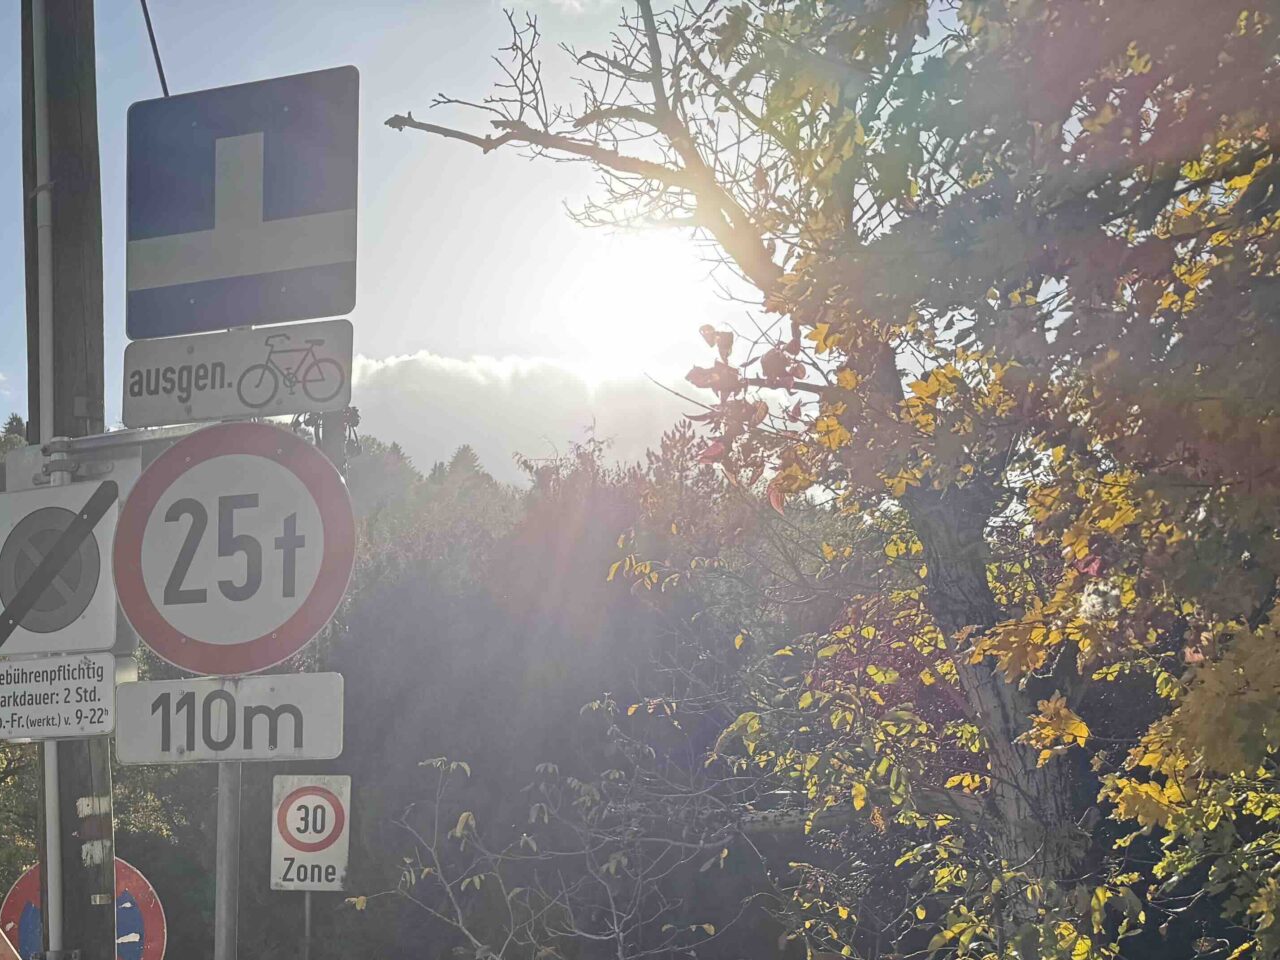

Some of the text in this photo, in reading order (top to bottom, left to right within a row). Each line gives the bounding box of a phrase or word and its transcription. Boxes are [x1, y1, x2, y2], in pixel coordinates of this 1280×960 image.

[129, 361, 233, 403] ausgen.
[63, 687, 71, 704] 2
[75, 686, 101, 703] Std.
[295, 804, 326, 834] 30
[282, 857, 337, 883] Zone
